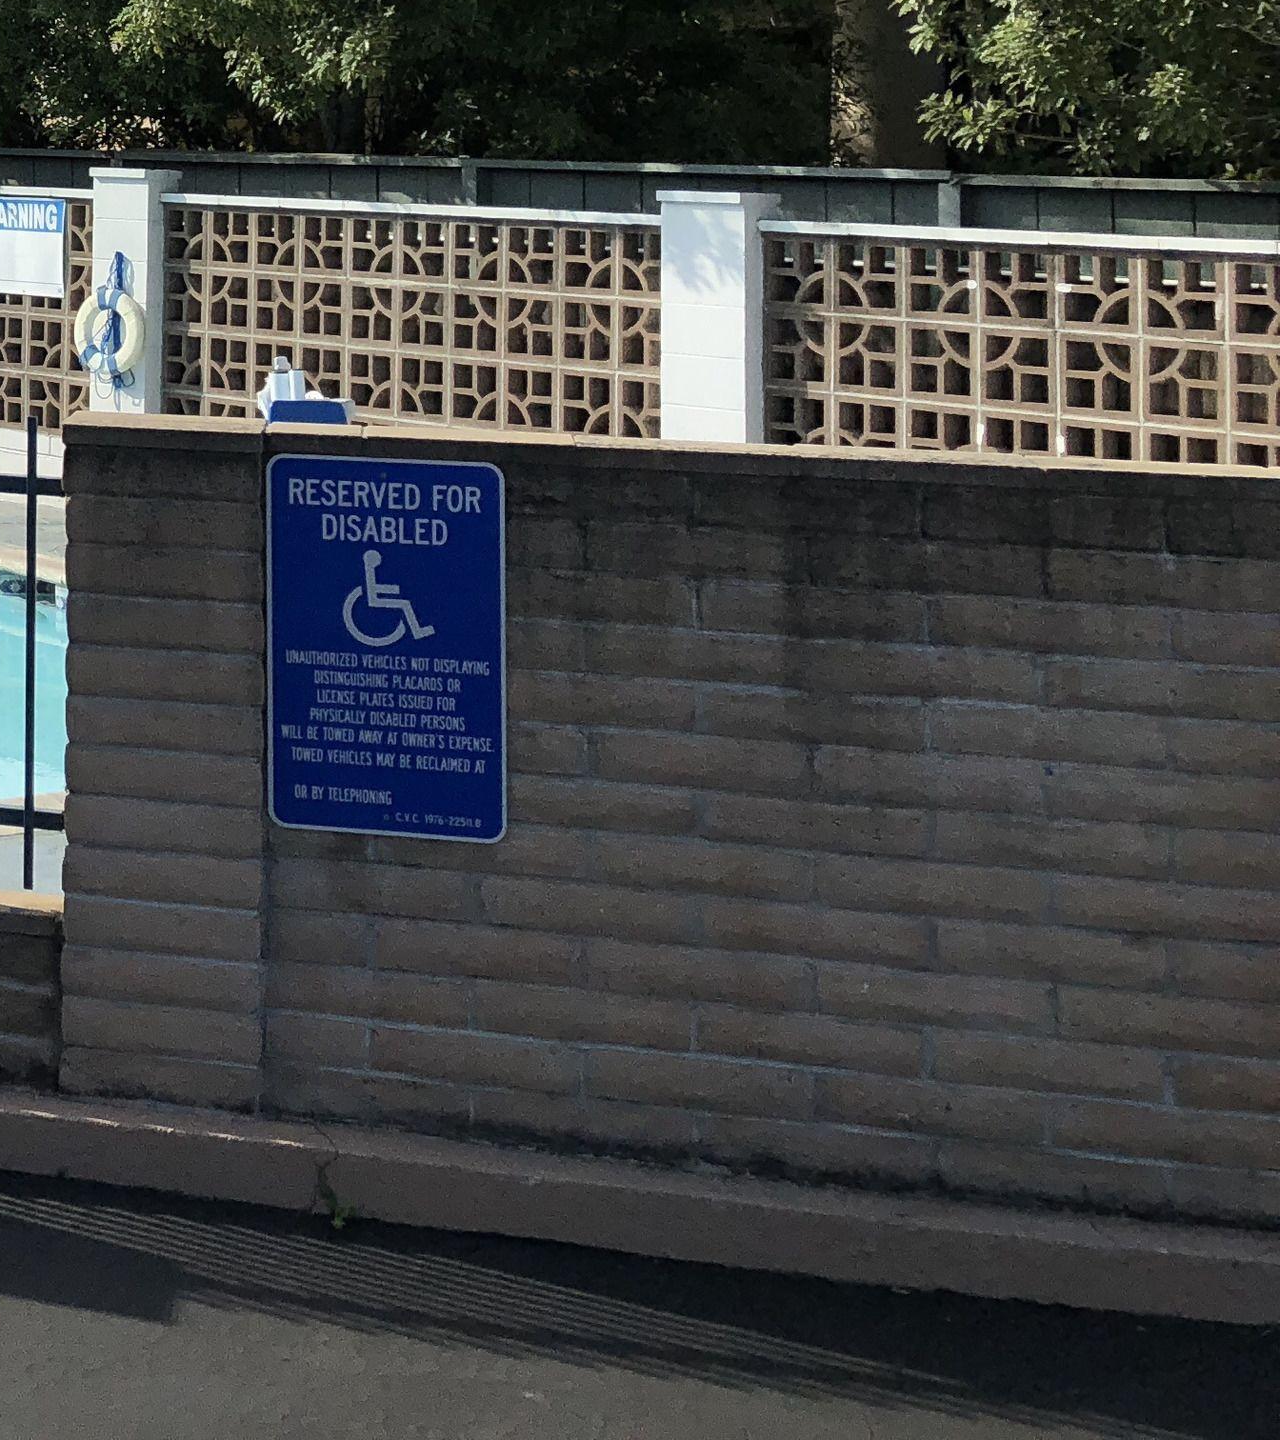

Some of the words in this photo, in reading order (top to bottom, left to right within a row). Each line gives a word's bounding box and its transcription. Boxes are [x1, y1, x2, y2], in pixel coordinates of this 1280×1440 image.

[288, 478, 421, 510] RESERVED
[432, 485, 481, 513] FOR
[321, 513, 448, 545] DISABLED
[286, 649, 358, 667] UNAUTHORIZED
[361, 654, 407, 670] VEHICLES
[411, 657, 430, 671] NOT
[434, 658, 490, 676] DISPLAYING
[314, 670, 389, 688] DISTINGUISHING
[392, 676, 443, 692] PLACARDS
[447, 679, 461, 693] OR
[317, 689, 355, 705] LICENSE
[359, 692, 394, 707] PLATES
[399, 695, 433, 710] ISSUED
[436, 697, 456, 711] FOR
[310, 708, 366, 724] PHYSICALLY
[370, 711, 416, 727] DISABLED
[420, 715, 465, 731] PERSONS
[281, 724, 303, 739] WILL
[307, 726, 319, 740] BE
[323, 727, 354, 742] TOWED
[358, 730, 383, 745] AWAY
[387, 732, 397, 745] AT
[402, 733, 445, 750] OWNER'S
[449, 737, 495, 753] EXPENSE.
[291, 746, 323, 762] TOWED
[327, 750, 372, 766] VEHICLES
[376, 753, 396, 768] MAY
[400, 754, 412, 769] BE
[416, 755, 470, 773] RECLAIMED
[474, 760, 486, 774] AT
[294, 784, 308, 799] OR
[311, 786, 324, 800] BY
[328, 787, 392, 805] TELEPHONING
